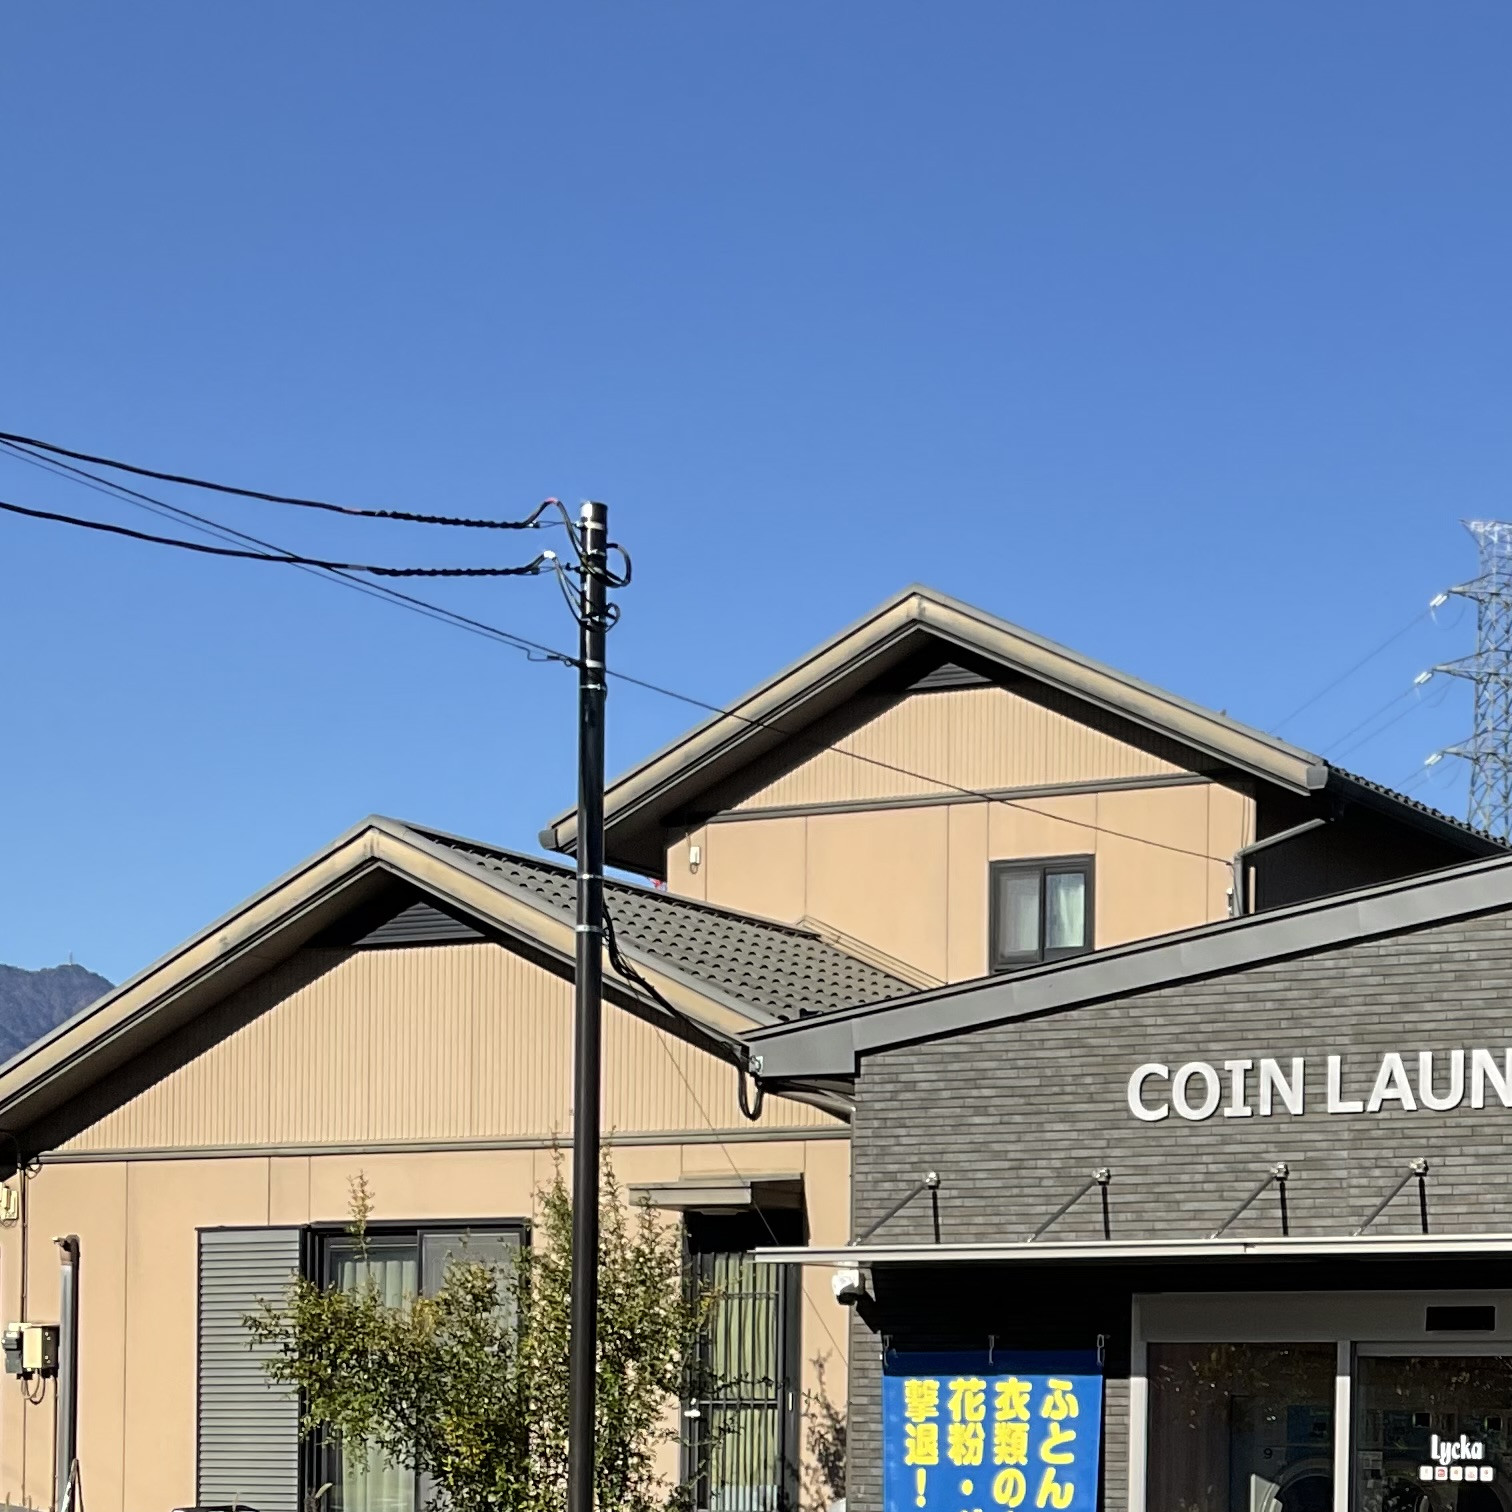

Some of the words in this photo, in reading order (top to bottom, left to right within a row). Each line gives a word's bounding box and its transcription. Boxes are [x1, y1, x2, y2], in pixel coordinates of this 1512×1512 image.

[1127, 1057, 1305, 1122] COIN
[904, 1378, 940, 1508] 撃退！
[1430, 1434, 1483, 1466] Lycka
